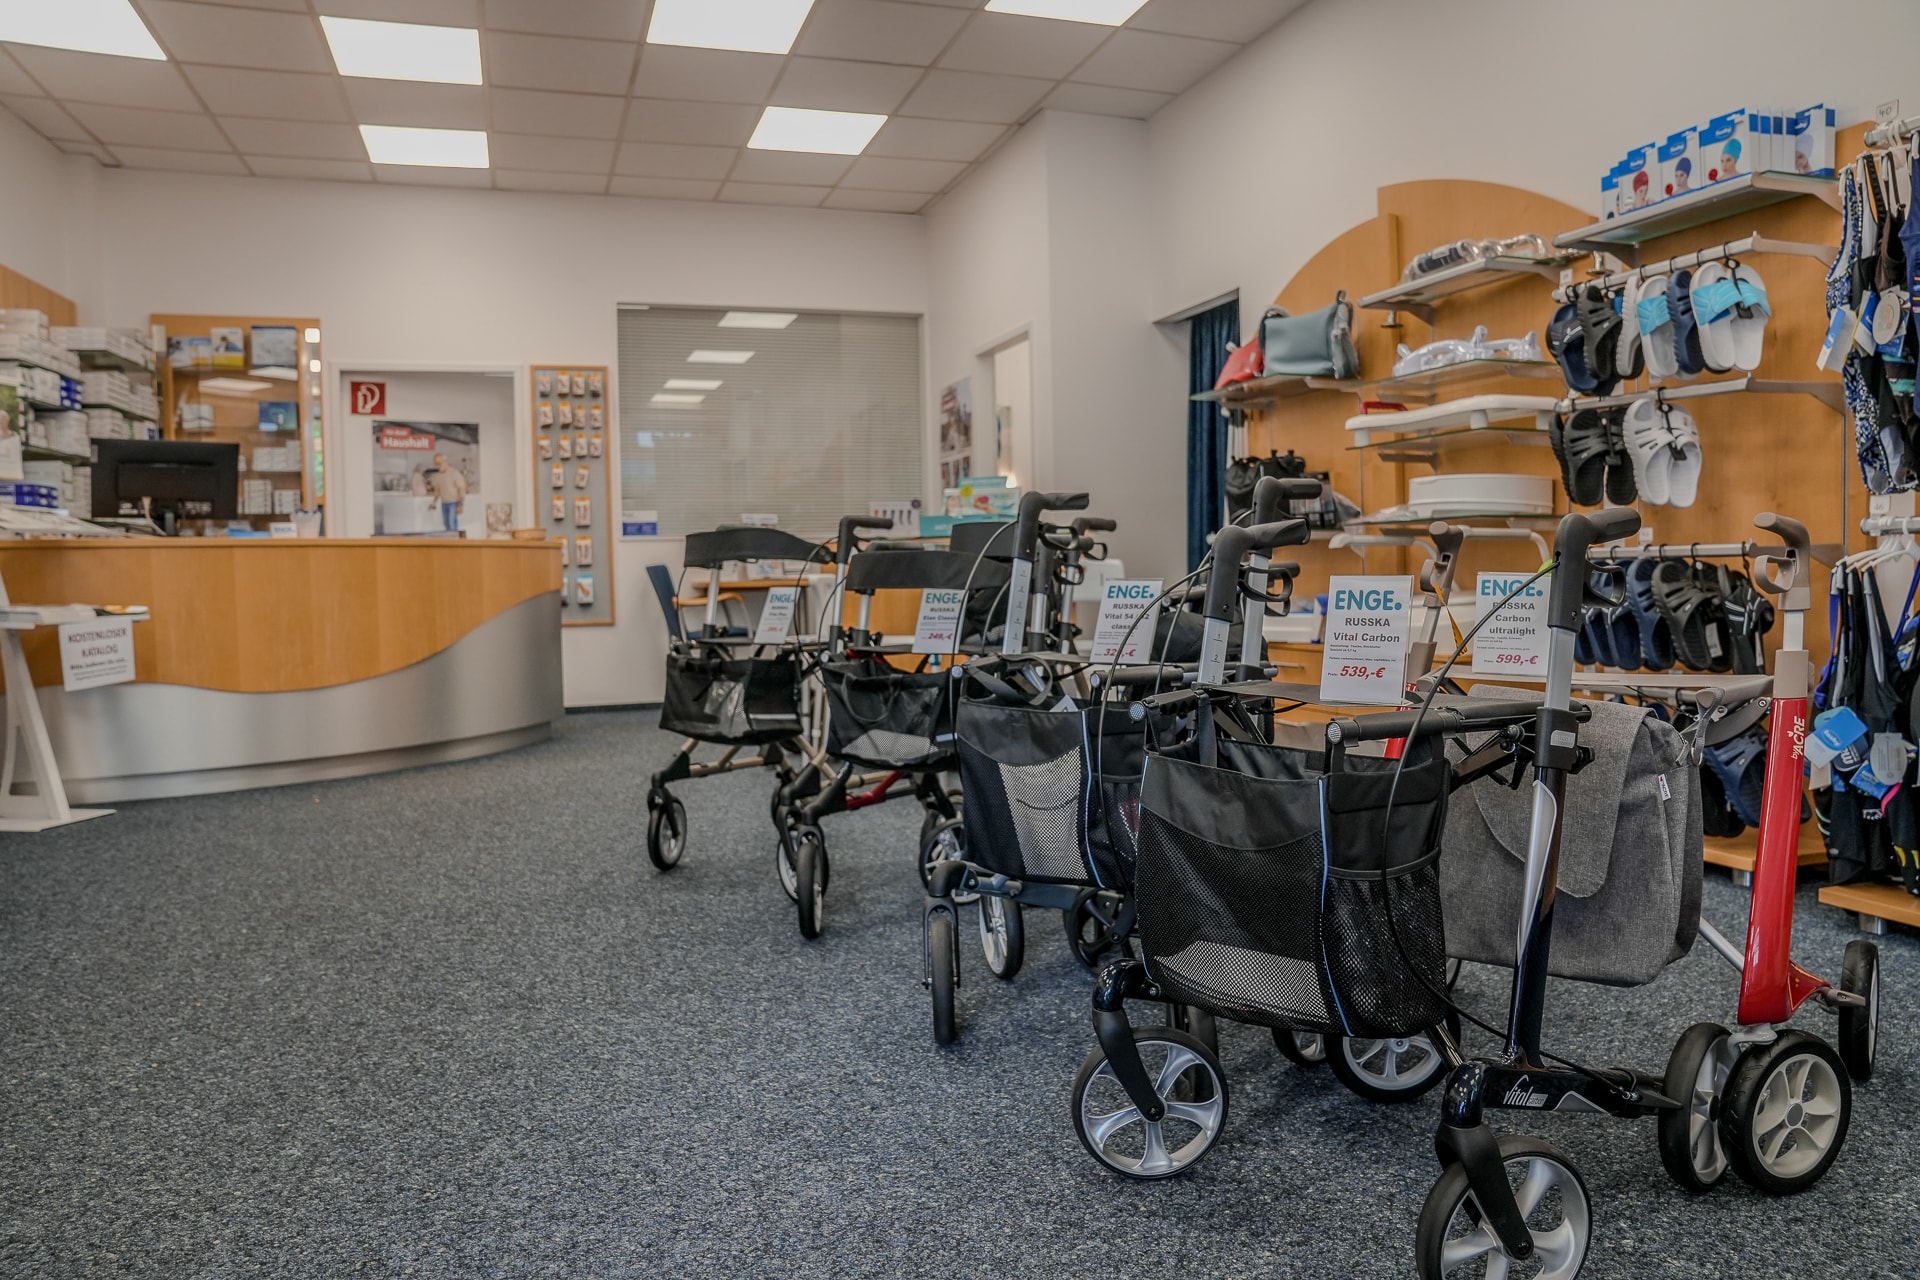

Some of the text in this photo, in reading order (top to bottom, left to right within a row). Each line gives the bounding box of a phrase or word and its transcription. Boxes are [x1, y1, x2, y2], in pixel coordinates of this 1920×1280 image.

[1878, 106, 1892, 117] 40
[383, 436, 429, 448] Haushalt
[1107, 585, 1155, 599] ENGE.
[1335, 589, 1402, 611] ENGE.
[1345, 617, 1390, 627] RUSSKA
[1495, 614, 1531, 622] Carbon
[1333, 632, 1400, 642] Vital Carbon
[1489, 627, 1536, 636] ultralight
[1103, 648, 1136, 658] 32,-€
[1496, 654, 1538, 666] 599,-€
[1340, 665, 1385, 679] 539,-€
[1791, 716, 1805, 759] byACRE
[1503, 1074, 1534, 1106] Vital
